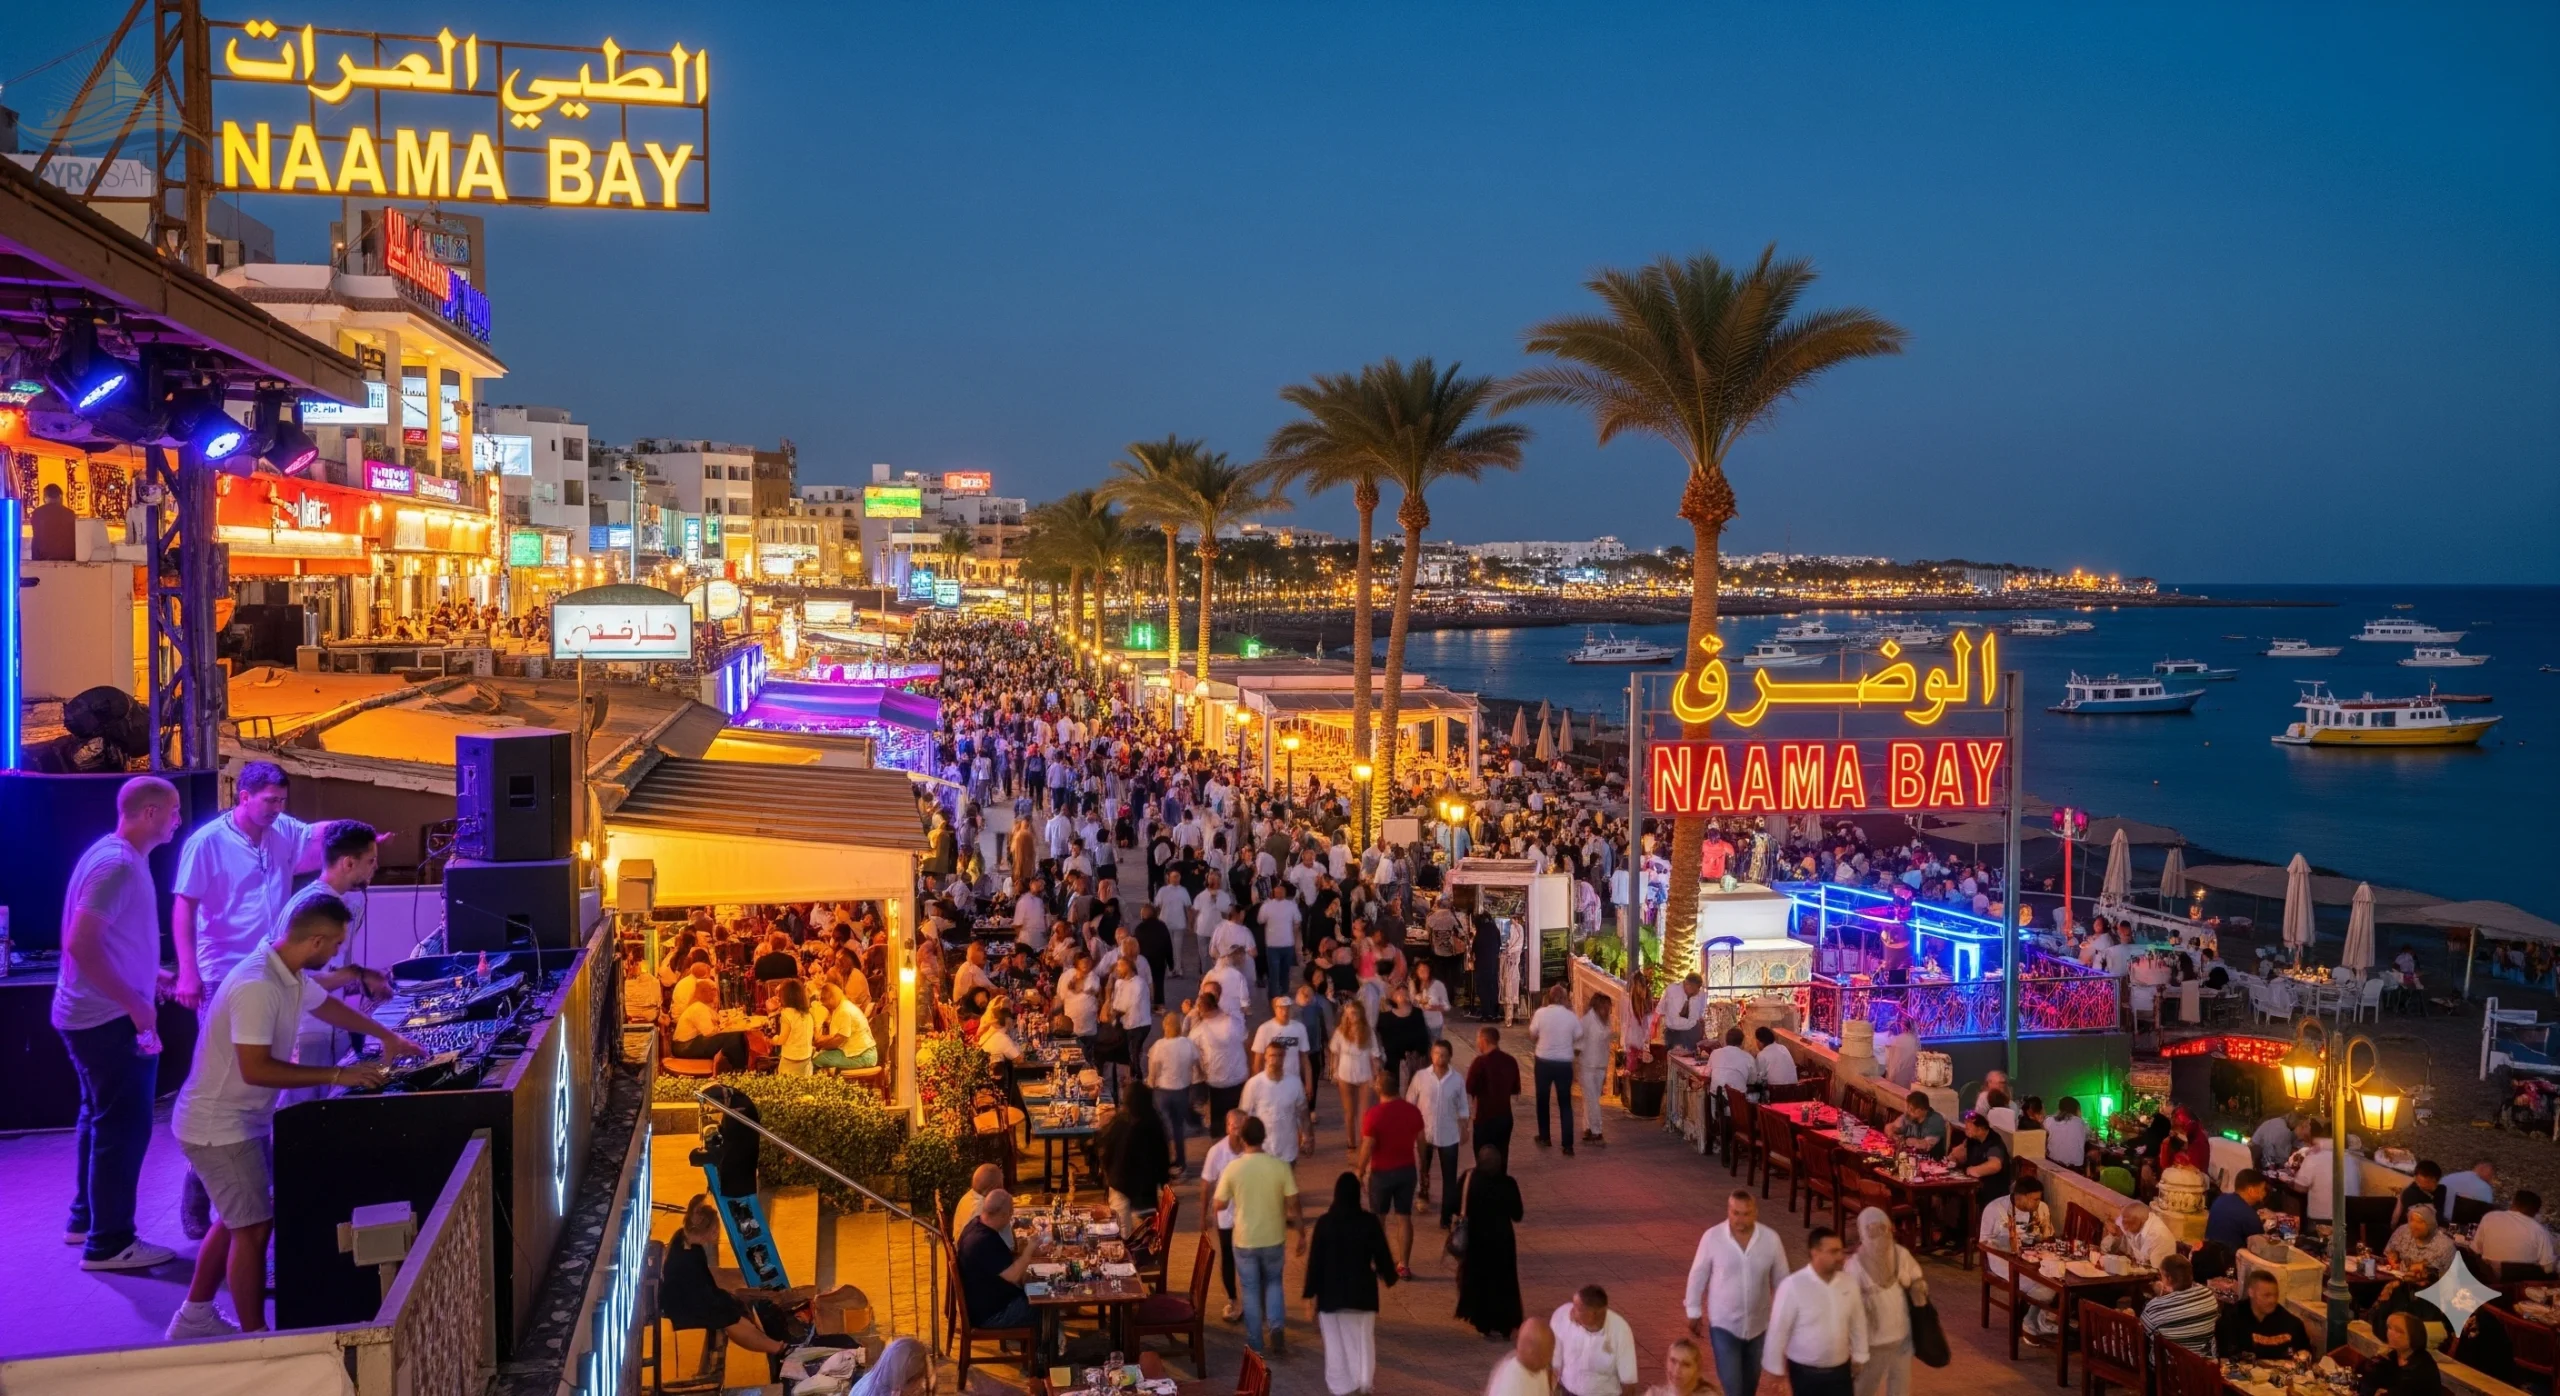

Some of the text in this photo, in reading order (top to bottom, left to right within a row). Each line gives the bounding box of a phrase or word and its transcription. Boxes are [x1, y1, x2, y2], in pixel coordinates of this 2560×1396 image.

[222, 120, 694, 208] NAAMA BAY
[1653, 742, 2002, 813] NAAMA BAY
